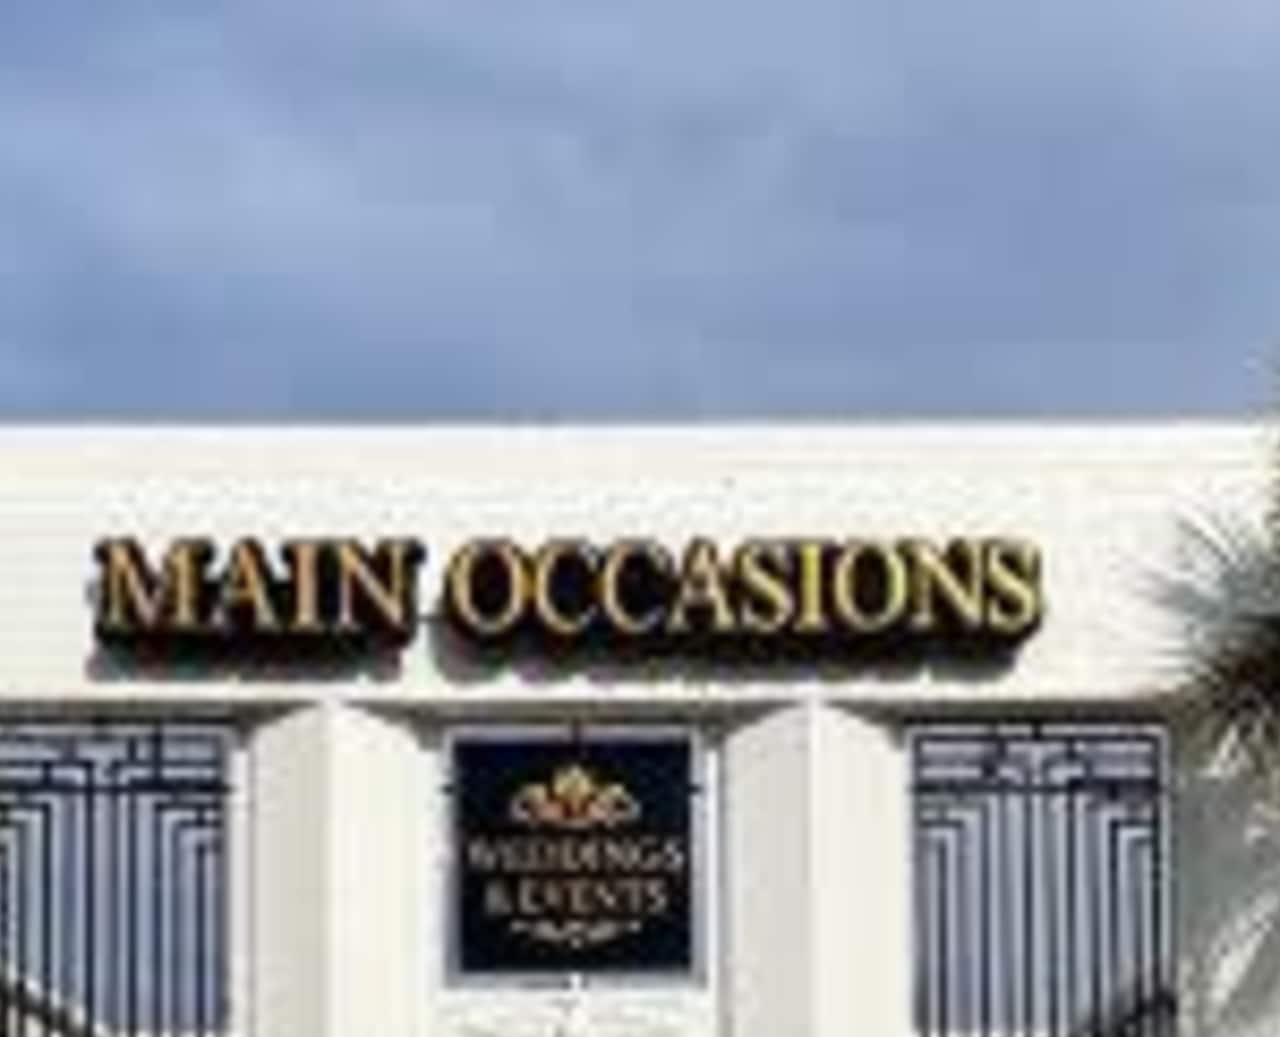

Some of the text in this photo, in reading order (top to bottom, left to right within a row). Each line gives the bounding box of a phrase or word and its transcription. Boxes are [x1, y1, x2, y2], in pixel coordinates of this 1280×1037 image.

[100, 536, 1042, 638] MAIN OCCASIONS
[468, 836, 684, 872] WEDDINGS
[519, 878, 669, 915] EVENTS
